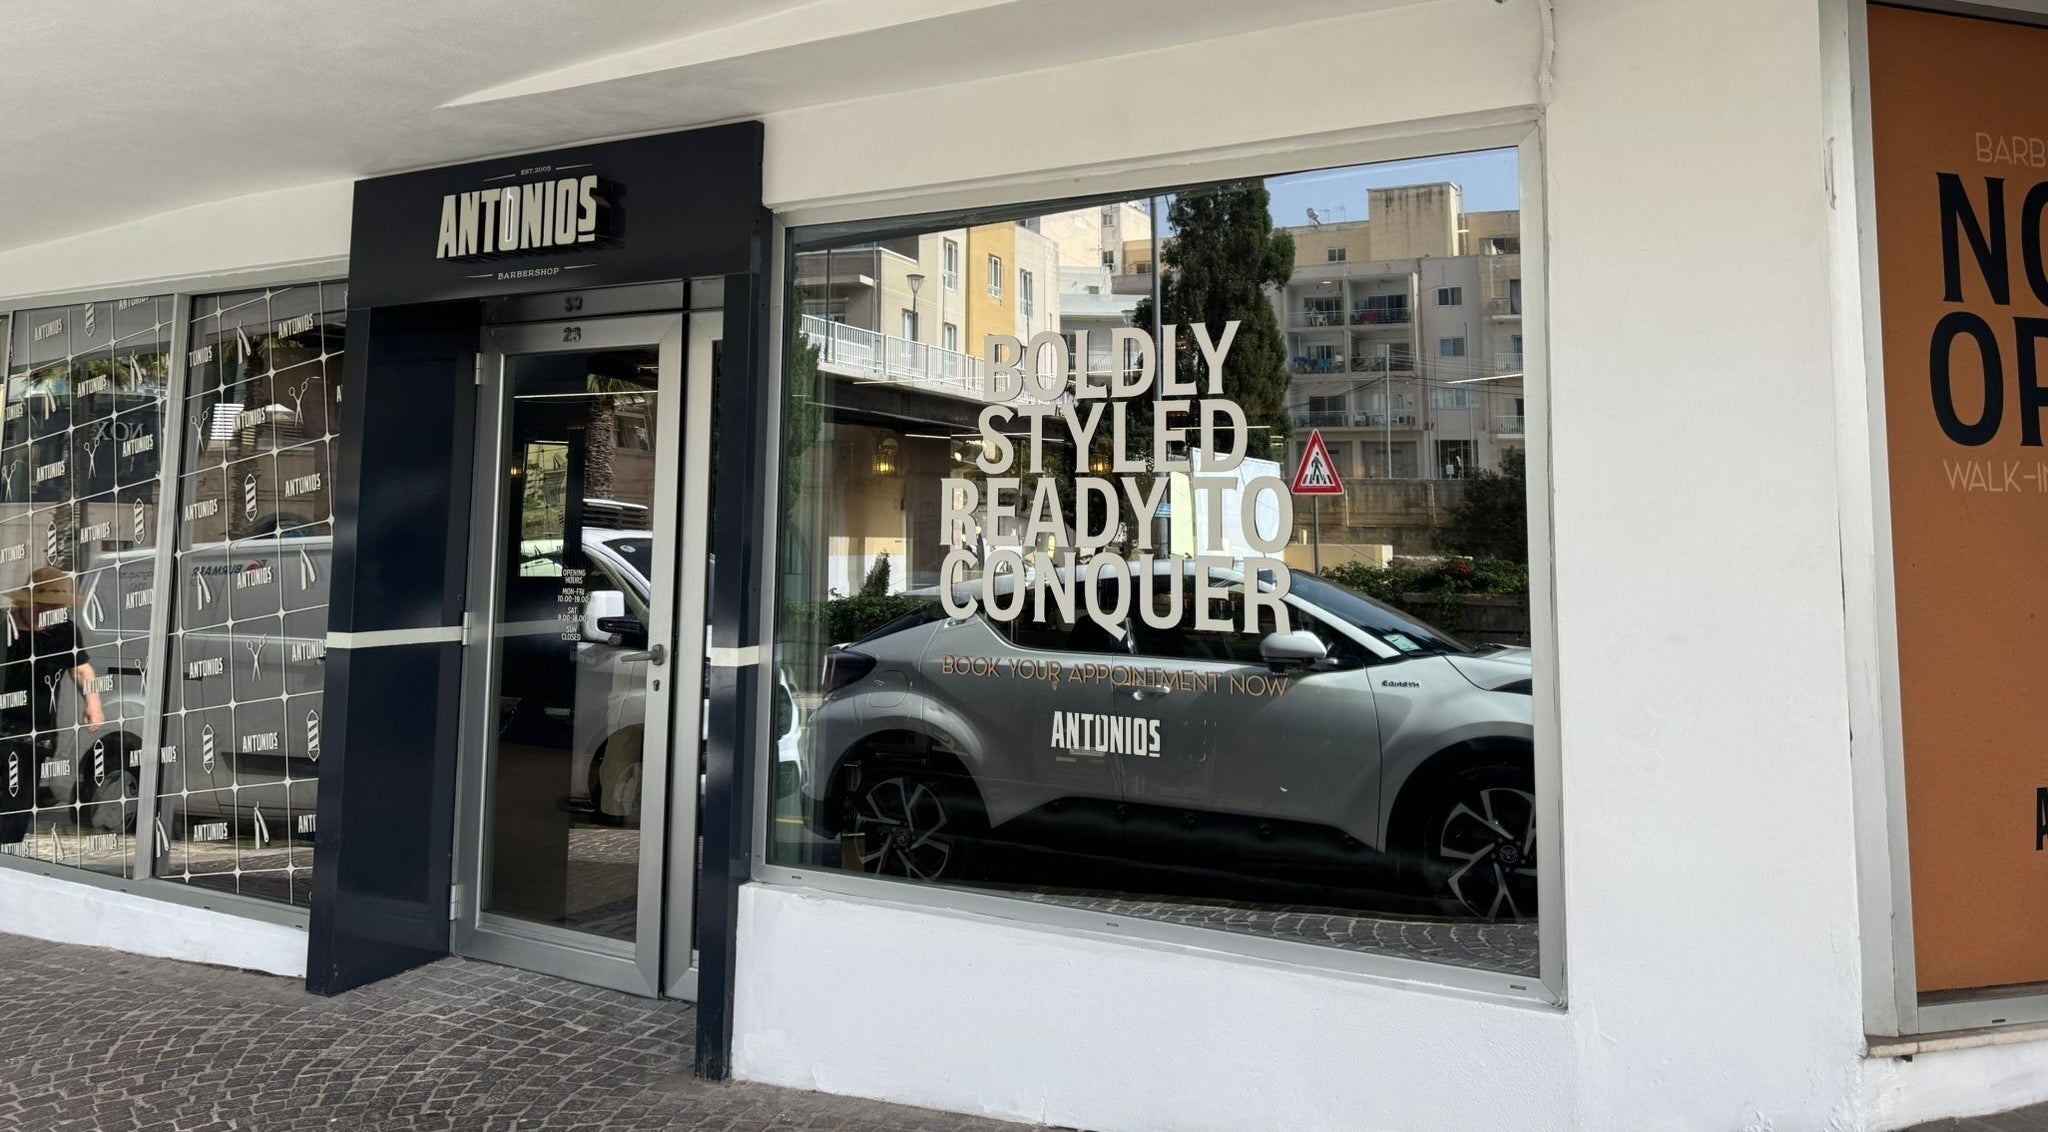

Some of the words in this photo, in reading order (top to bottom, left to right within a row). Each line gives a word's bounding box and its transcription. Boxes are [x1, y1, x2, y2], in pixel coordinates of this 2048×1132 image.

[1975, 131, 2048, 168] BARB
[436, 174, 598, 259] ANTONIOS
[497, 267, 560, 280] BARBERSHOP
[278, 313, 313, 339] ANTONIOS
[562, 326, 582, 343] 23
[189, 345, 213, 367] TONIOS
[984, 320, 1241, 402] BOLDLY
[976, 399, 1248, 475] STYLED
[285, 473, 321, 497] ANTONIOS
[184, 498, 218, 522] ANTONIOS
[940, 476, 1169, 550] READY
[1195, 476, 1293, 553] TO
[237, 566, 273, 589] ANTONIOS
[562, 569, 586, 577] OPENING
[940, 549, 1292, 642] CONQUER
[38, 607, 68, 628] ANTONIOS
[567, 606, 577, 614] SAT
[561, 633, 581, 641] CLOSED
[189, 657, 224, 679] ANTONIOS
[942, 654, 1001, 678] BOOK
[1008, 657, 1062, 682] YOUR
[1068, 663, 1222, 694] APPOINTMENT
[1229, 674, 1289, 698] NOW
[242, 732, 278, 753] ANTONIOS
[1051, 710, 1161, 758] ANTONIOS
[40, 759, 70, 779] ANTONIOS
[193, 822, 228, 842] ANTONIOS
